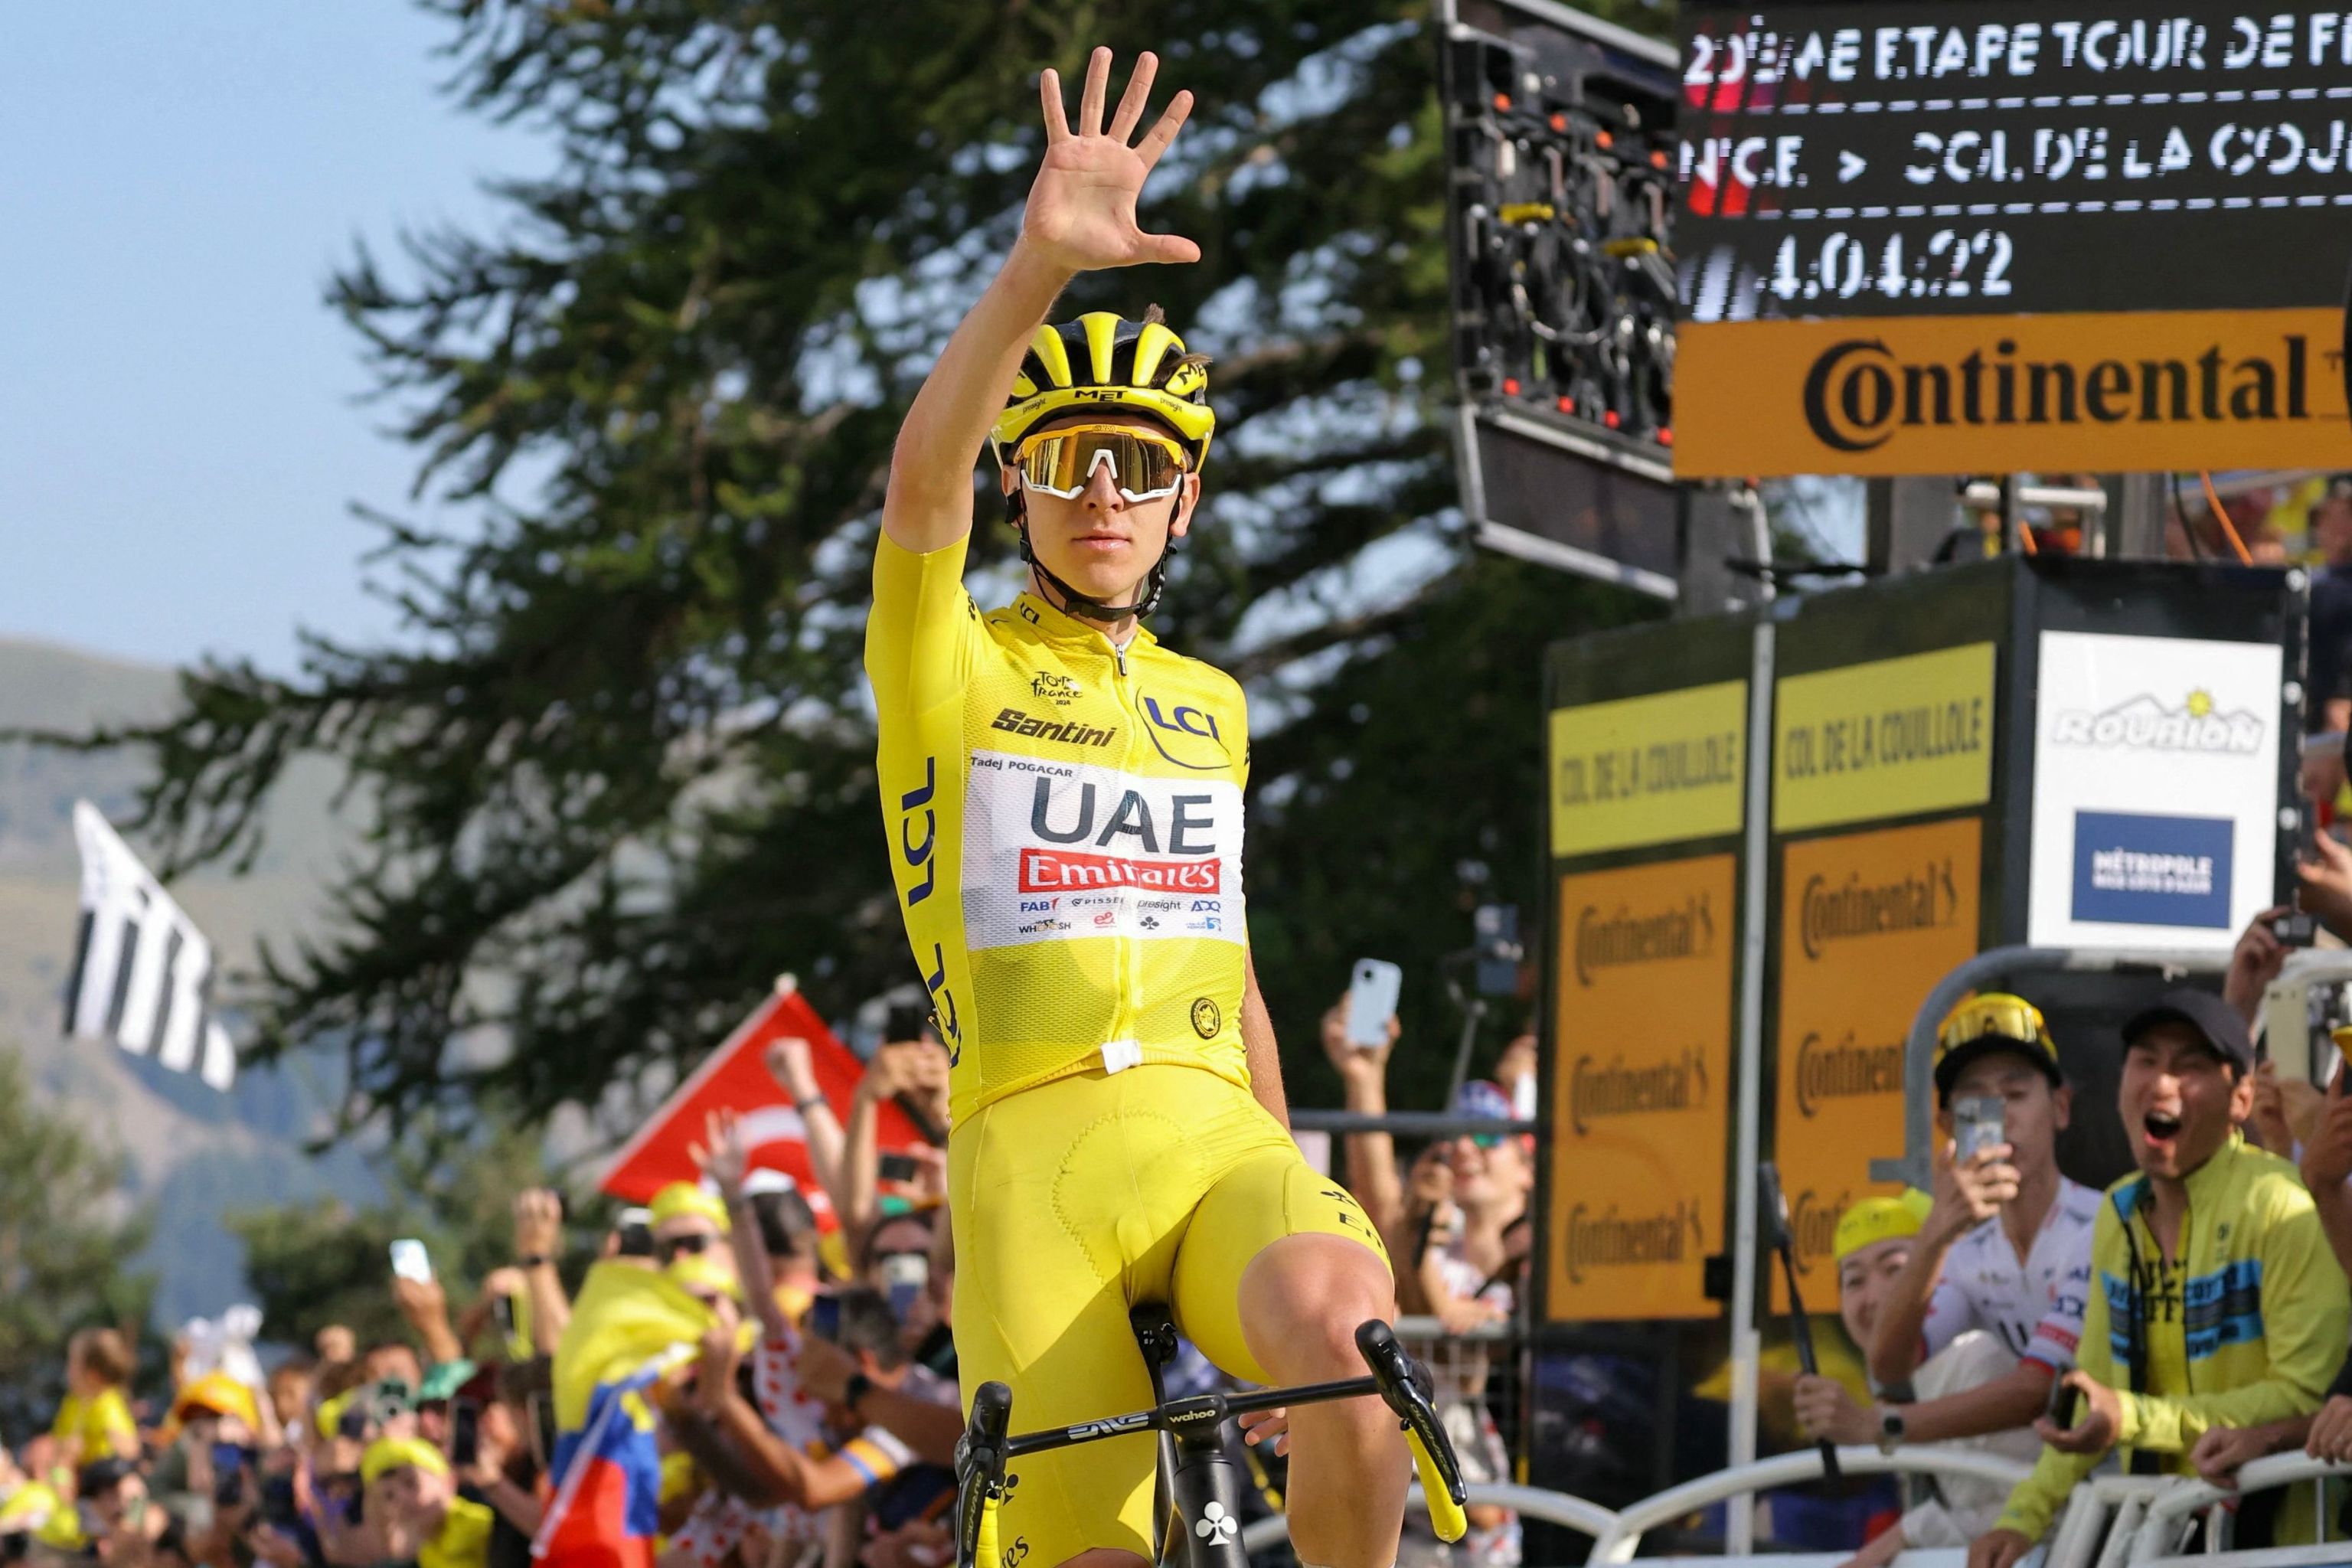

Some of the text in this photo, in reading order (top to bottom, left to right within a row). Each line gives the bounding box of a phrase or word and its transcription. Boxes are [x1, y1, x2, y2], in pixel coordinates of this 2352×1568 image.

[1875, 22, 2042, 80] ETAPE
[2051, 18, 2207, 73] TOUR
[2223, 13, 2295, 69] DE
[1678, 135, 1808, 188] NICE
[1903, 129, 2025, 185] COL
[2033, 126, 2109, 181] DE
[2122, 124, 2193, 180] LA
[1022, 397, 1047, 415] presight
[1074, 390, 1128, 403] MET
[1159, 397, 1183, 413] presight
[1804, 335, 2310, 452] Continental
[991, 708, 1118, 747] Santini
[1787, 696, 1981, 780] COL DE LA COUILLOLE
[970, 756, 1073, 778] Tadej POGACAR
[901, 755, 935, 907] LCL
[1031, 776, 1217, 855] UAE
[1027, 855, 1217, 889] Emirates
[1021, 901, 1050, 913] FAB
[1084, 897, 1125, 905] PISSEI
[1137, 899, 1181, 913] presight
[1801, 861, 1936, 961] Continental
[1796, 1028, 1905, 1119] Continen
[1169, 1410, 1217, 1423] wahoo
